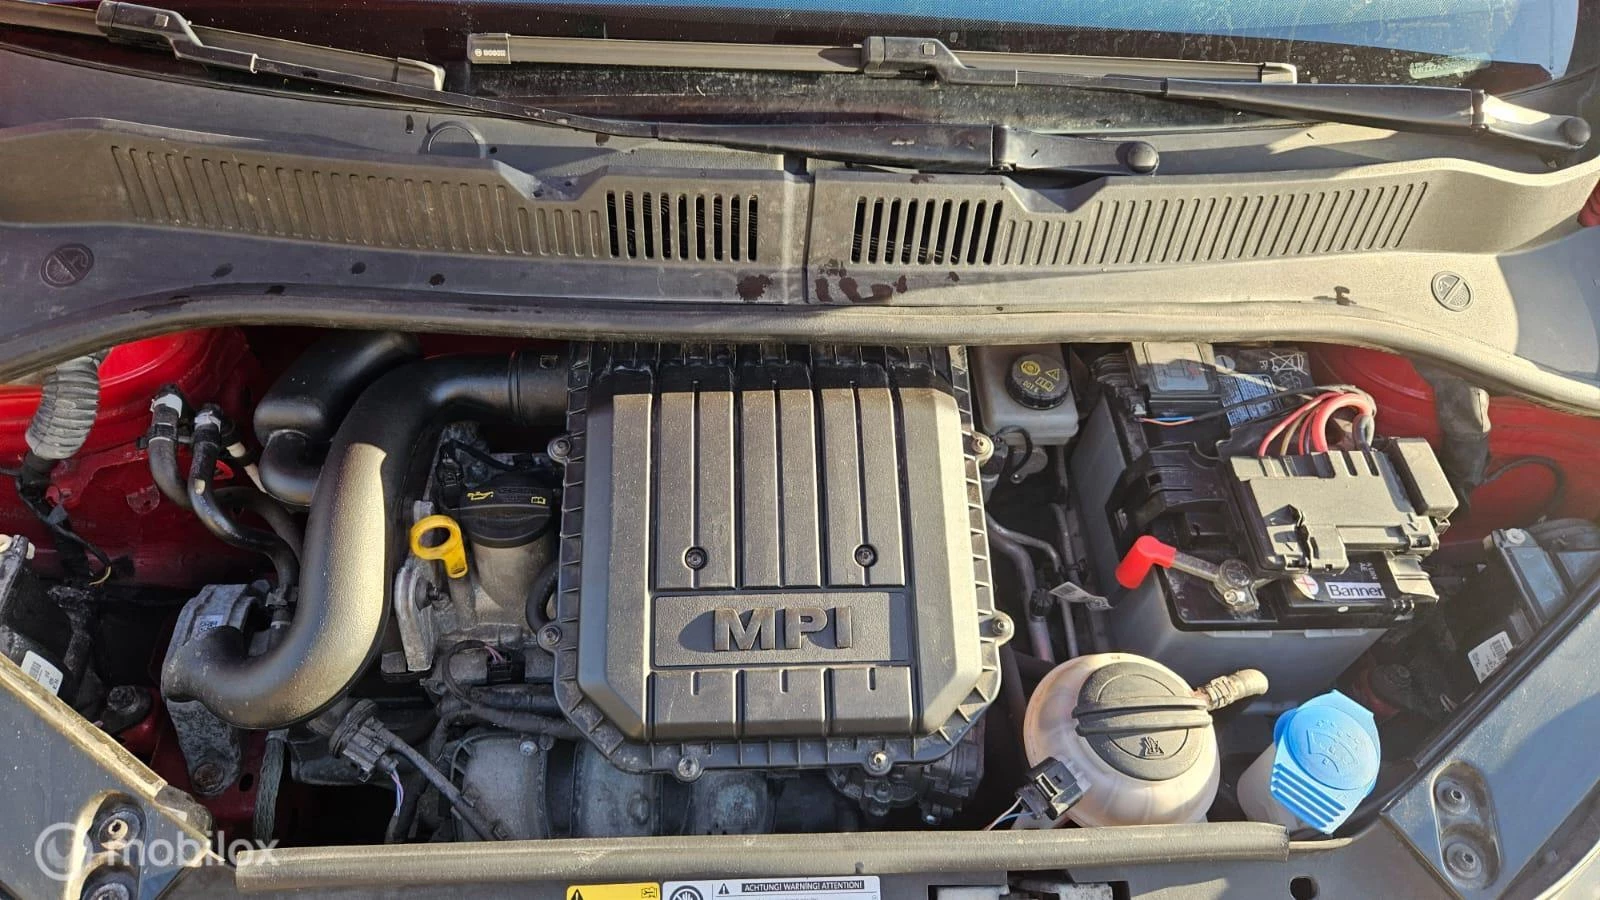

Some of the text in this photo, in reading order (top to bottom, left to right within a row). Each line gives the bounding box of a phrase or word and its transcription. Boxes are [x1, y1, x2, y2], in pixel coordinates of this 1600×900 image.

[1328, 584, 1384, 597] Banner
[714, 607, 853, 651] MPI
[744, 880, 863, 892] ACHTUNG! WARNING! ATTENTION!
